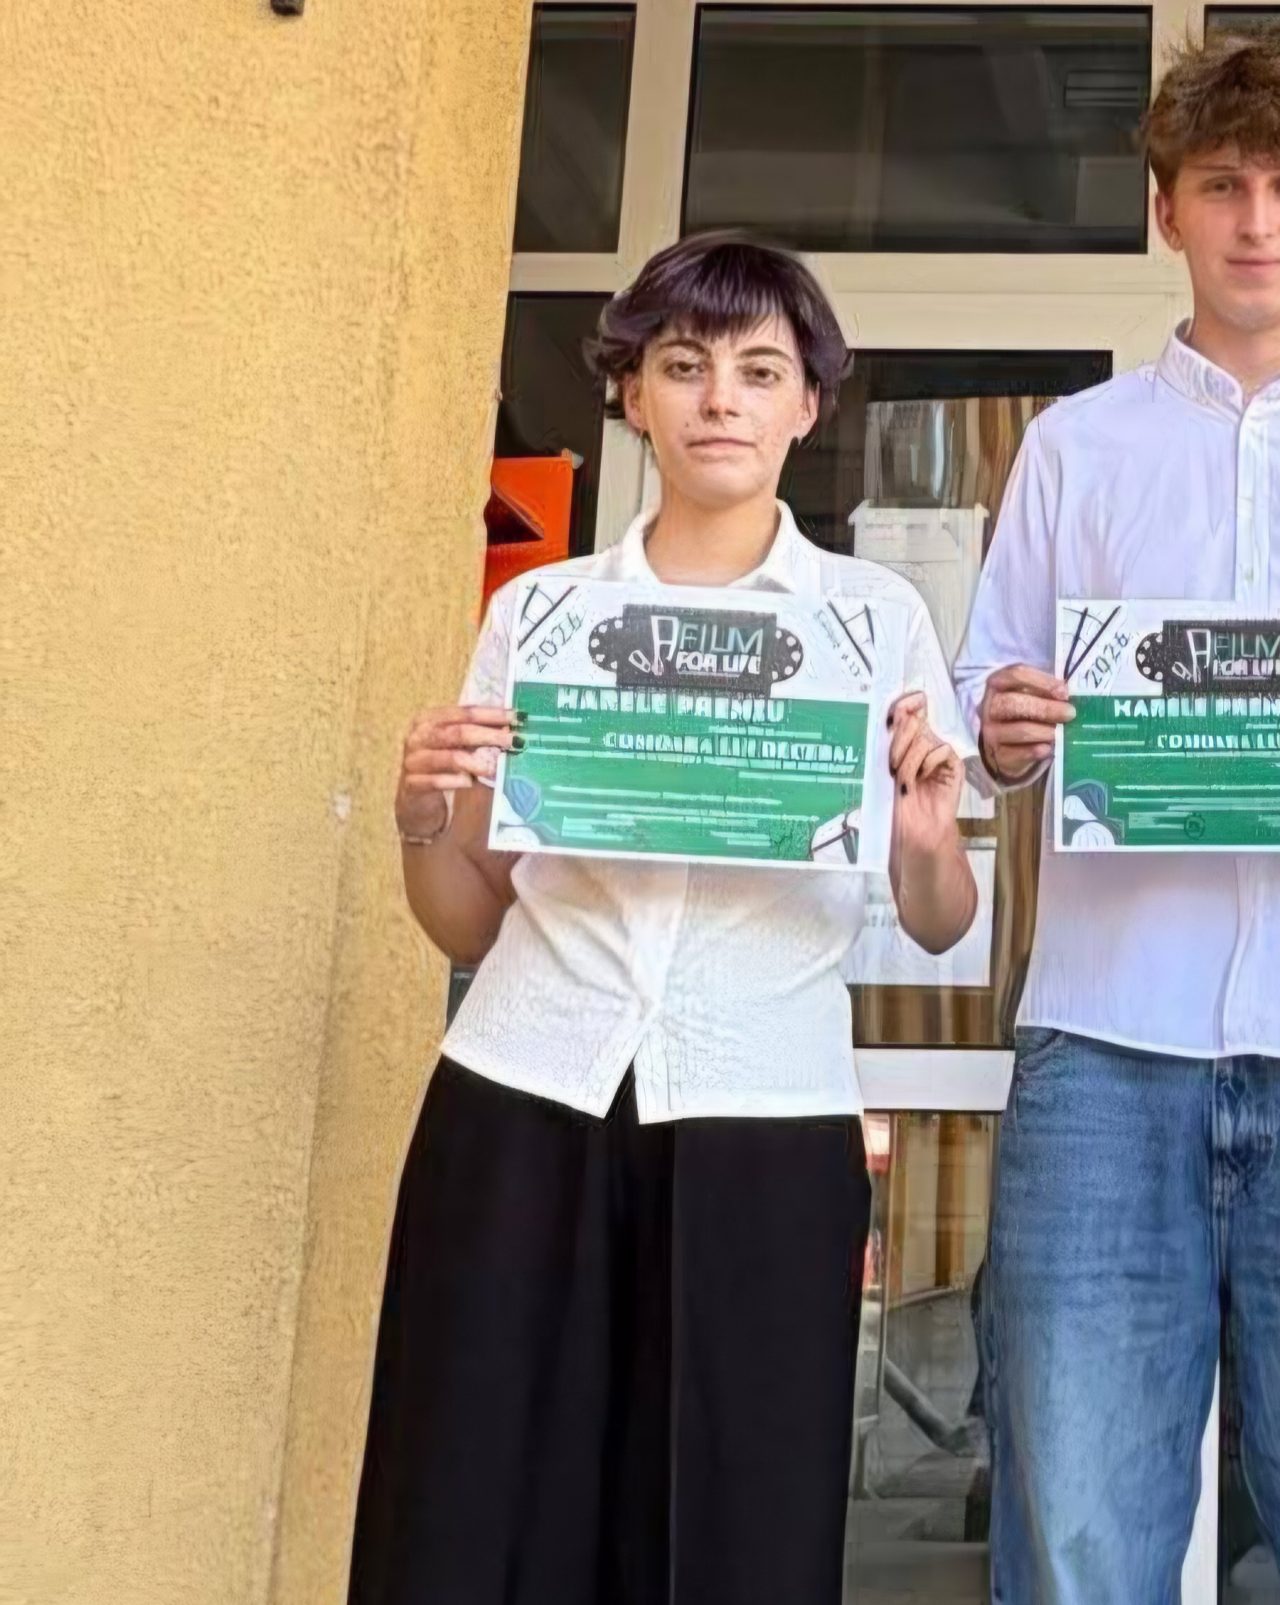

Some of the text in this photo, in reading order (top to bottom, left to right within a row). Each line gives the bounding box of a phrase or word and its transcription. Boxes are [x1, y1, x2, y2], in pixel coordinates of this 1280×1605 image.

[679, 622, 763, 654] FILM
[676, 651, 717, 672] FOR
[1084, 632, 1129, 688] 2026
